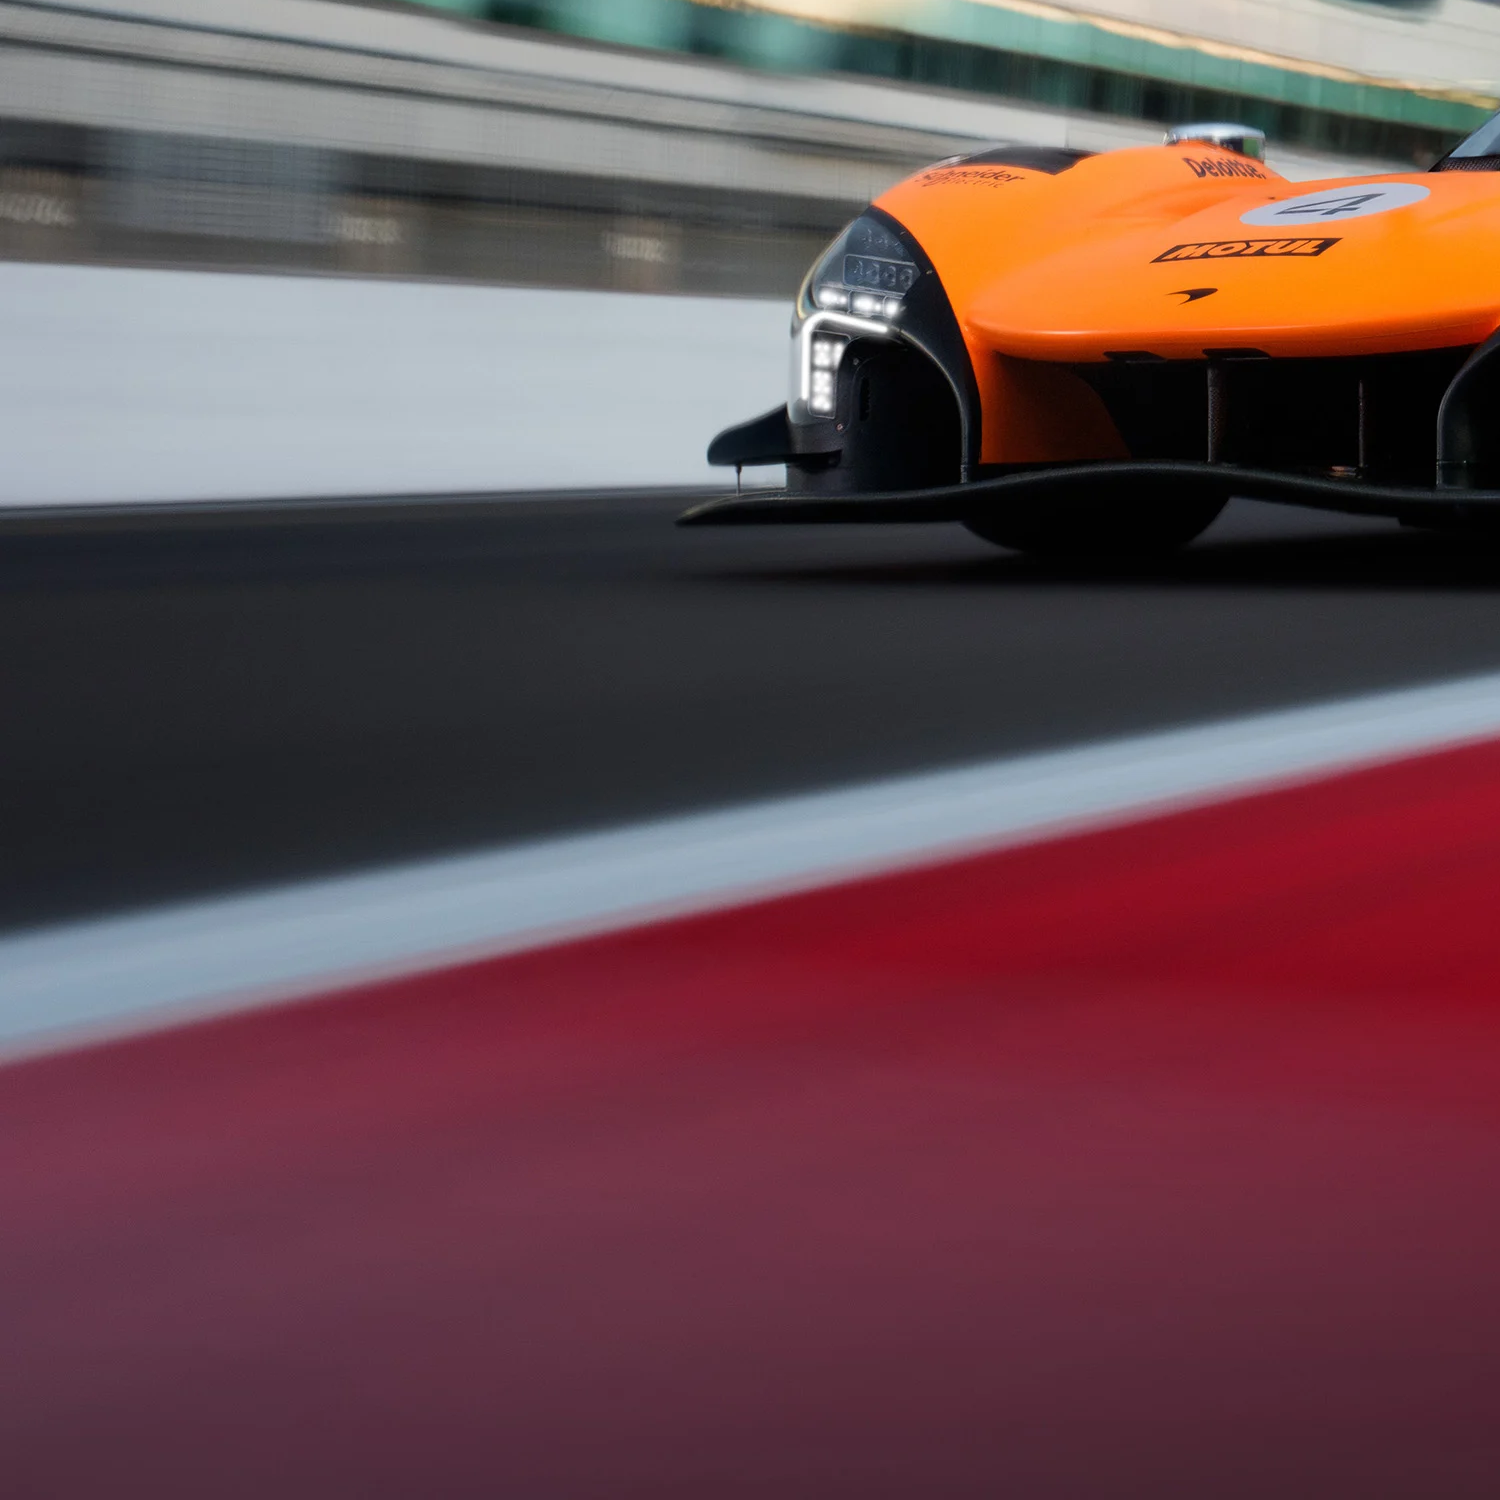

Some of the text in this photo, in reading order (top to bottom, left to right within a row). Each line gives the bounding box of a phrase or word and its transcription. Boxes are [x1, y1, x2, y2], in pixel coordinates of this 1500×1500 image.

[1183, 157, 1267, 179] Deloitte.
[1274, 193, 1387, 216] 4
[1167, 239, 1325, 260] MOTUL
